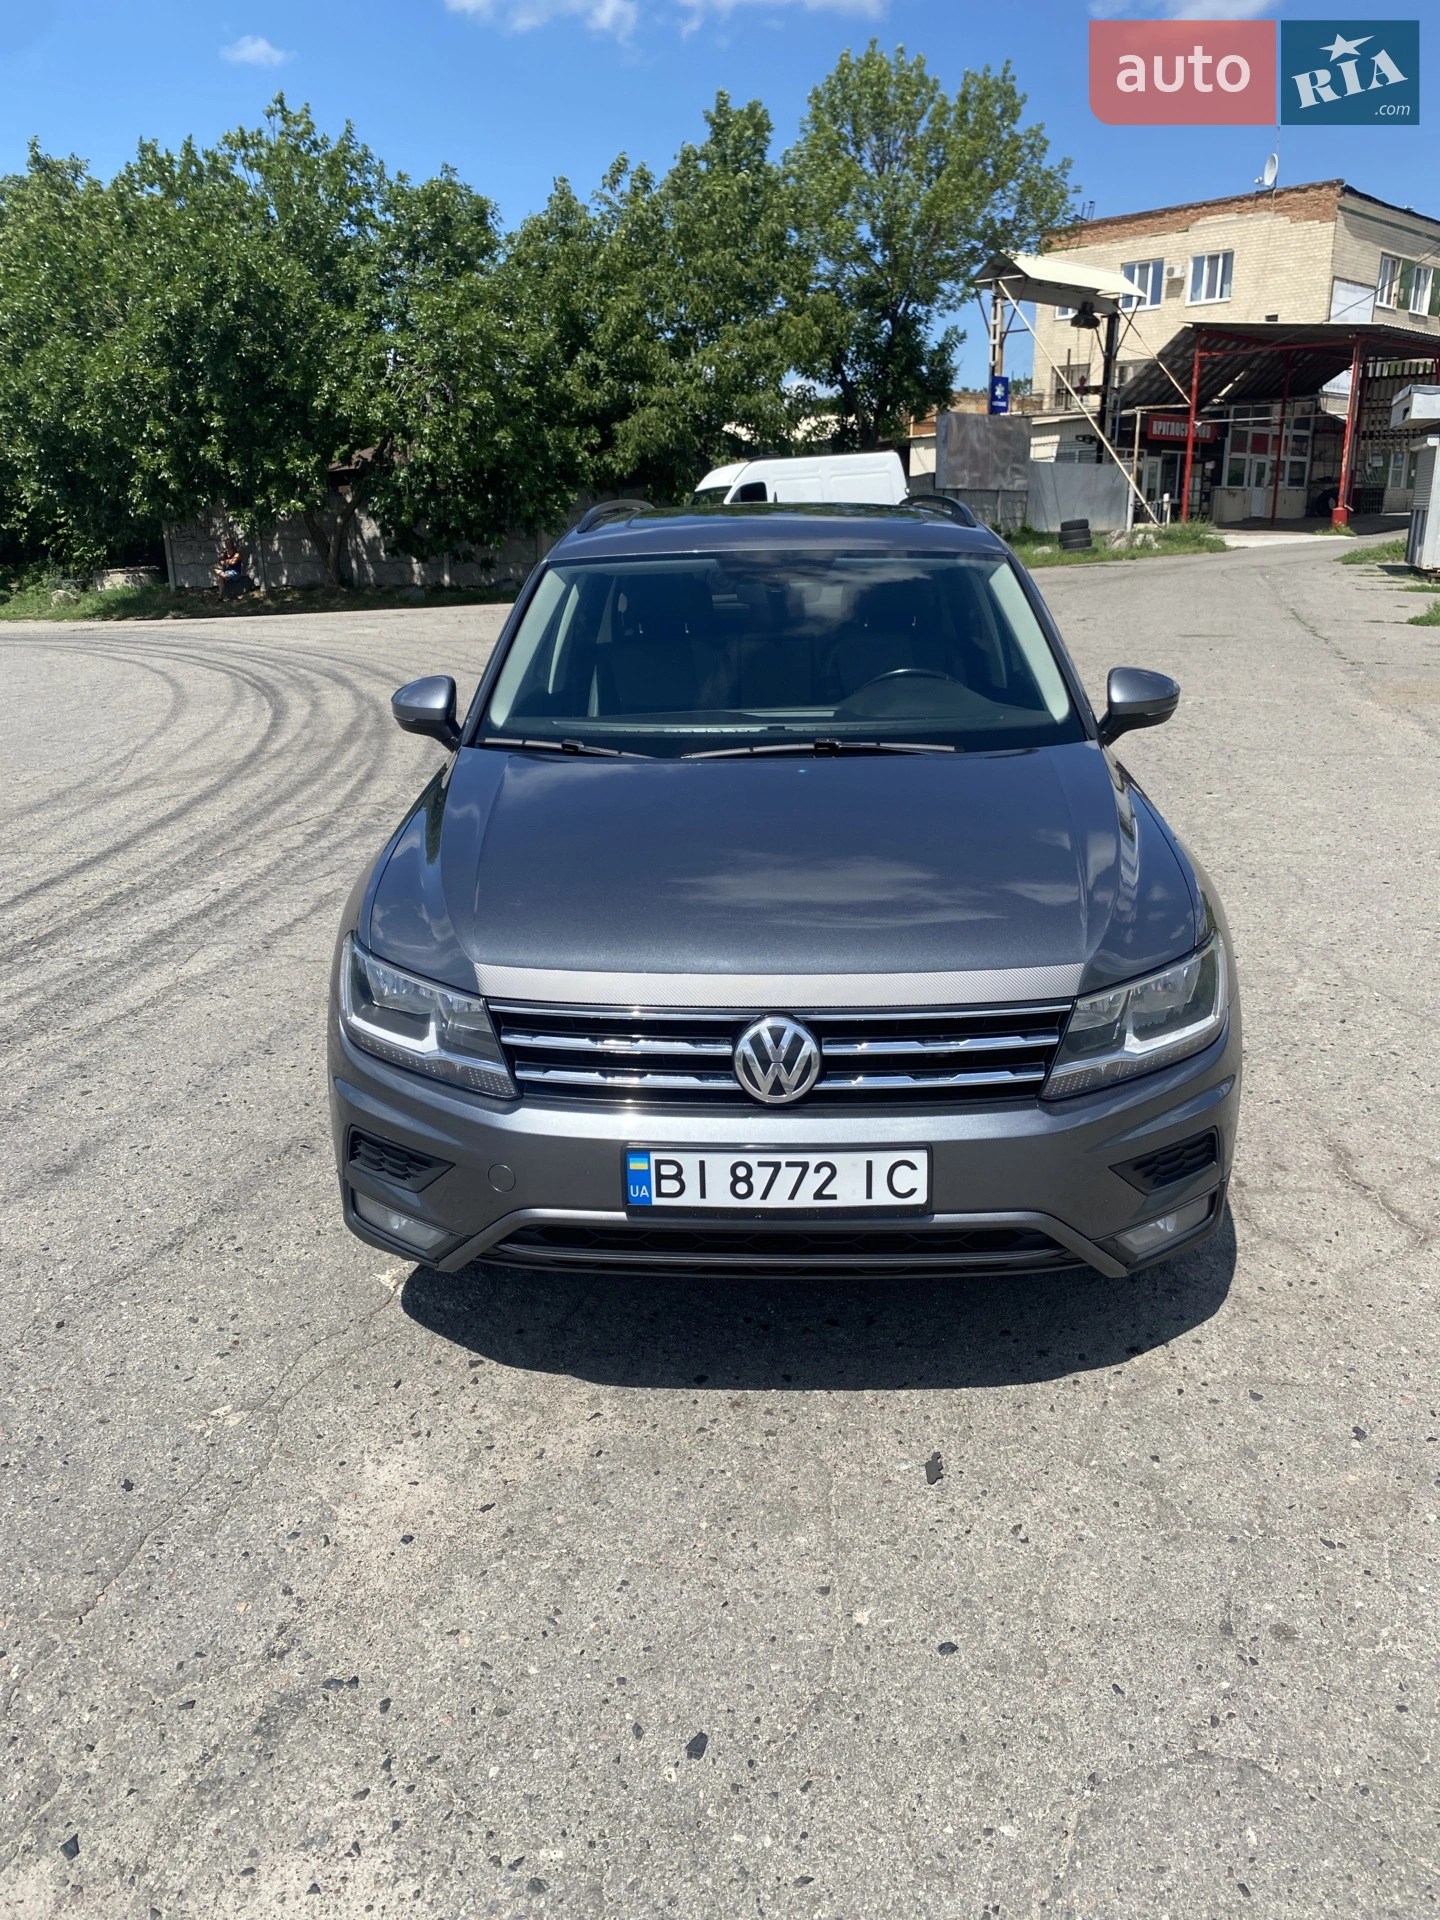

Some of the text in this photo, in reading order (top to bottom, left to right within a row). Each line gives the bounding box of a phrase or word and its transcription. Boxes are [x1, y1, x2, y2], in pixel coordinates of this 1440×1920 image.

[1152, 420, 1211, 440] КРУГЛОСУЧНО
[654, 1158, 919, 1200] BI 8772 IC
[630, 1184, 650, 1197] UA
